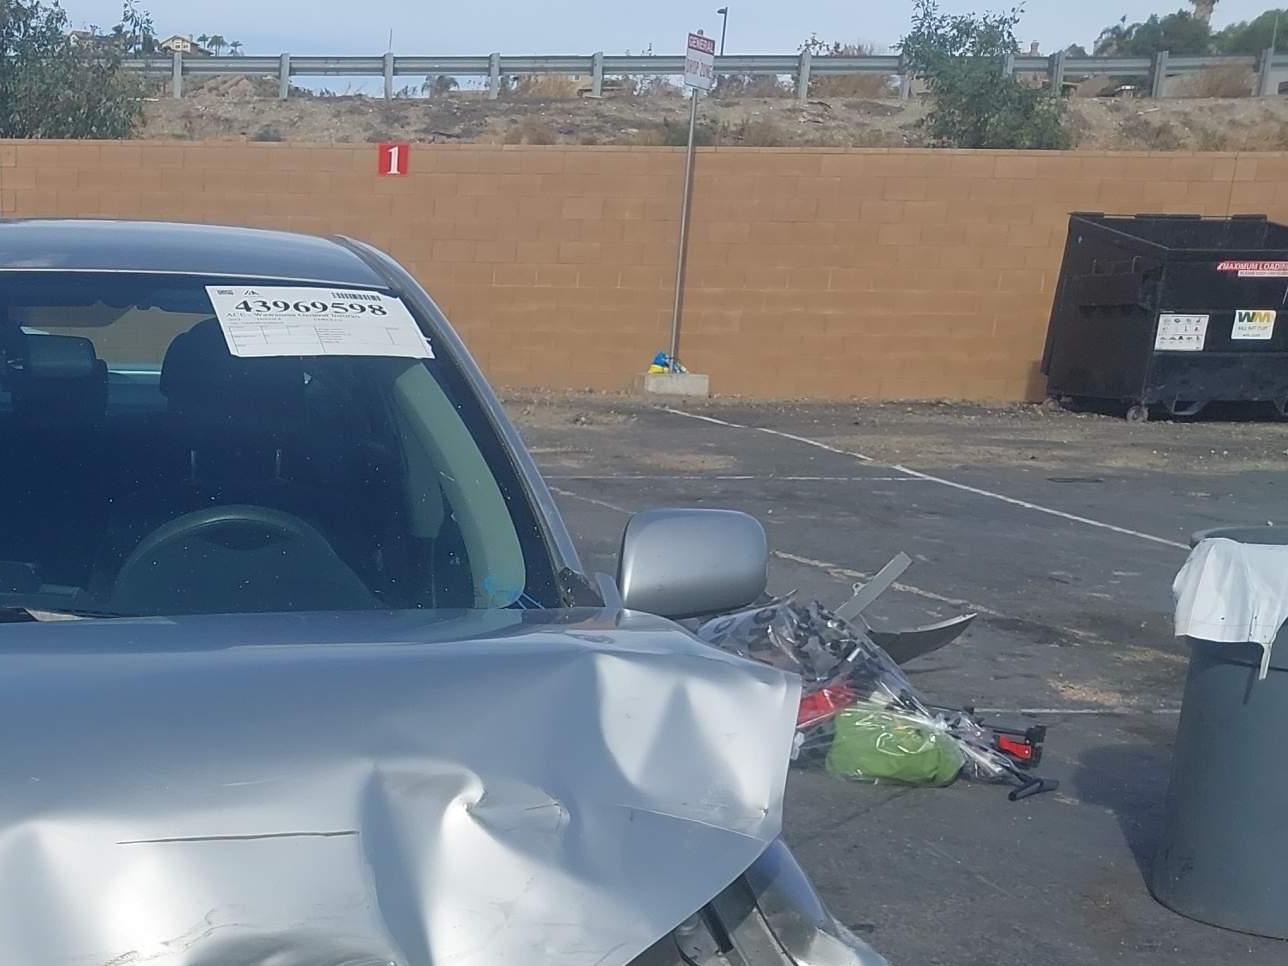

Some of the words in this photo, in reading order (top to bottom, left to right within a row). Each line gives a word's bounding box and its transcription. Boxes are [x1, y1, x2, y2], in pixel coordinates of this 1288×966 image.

[689, 36, 714, 53] GENERAL
[386, 145, 401, 175] 1
[234, 299, 389, 317] 43969598
[1237, 311, 1272, 323] WM
